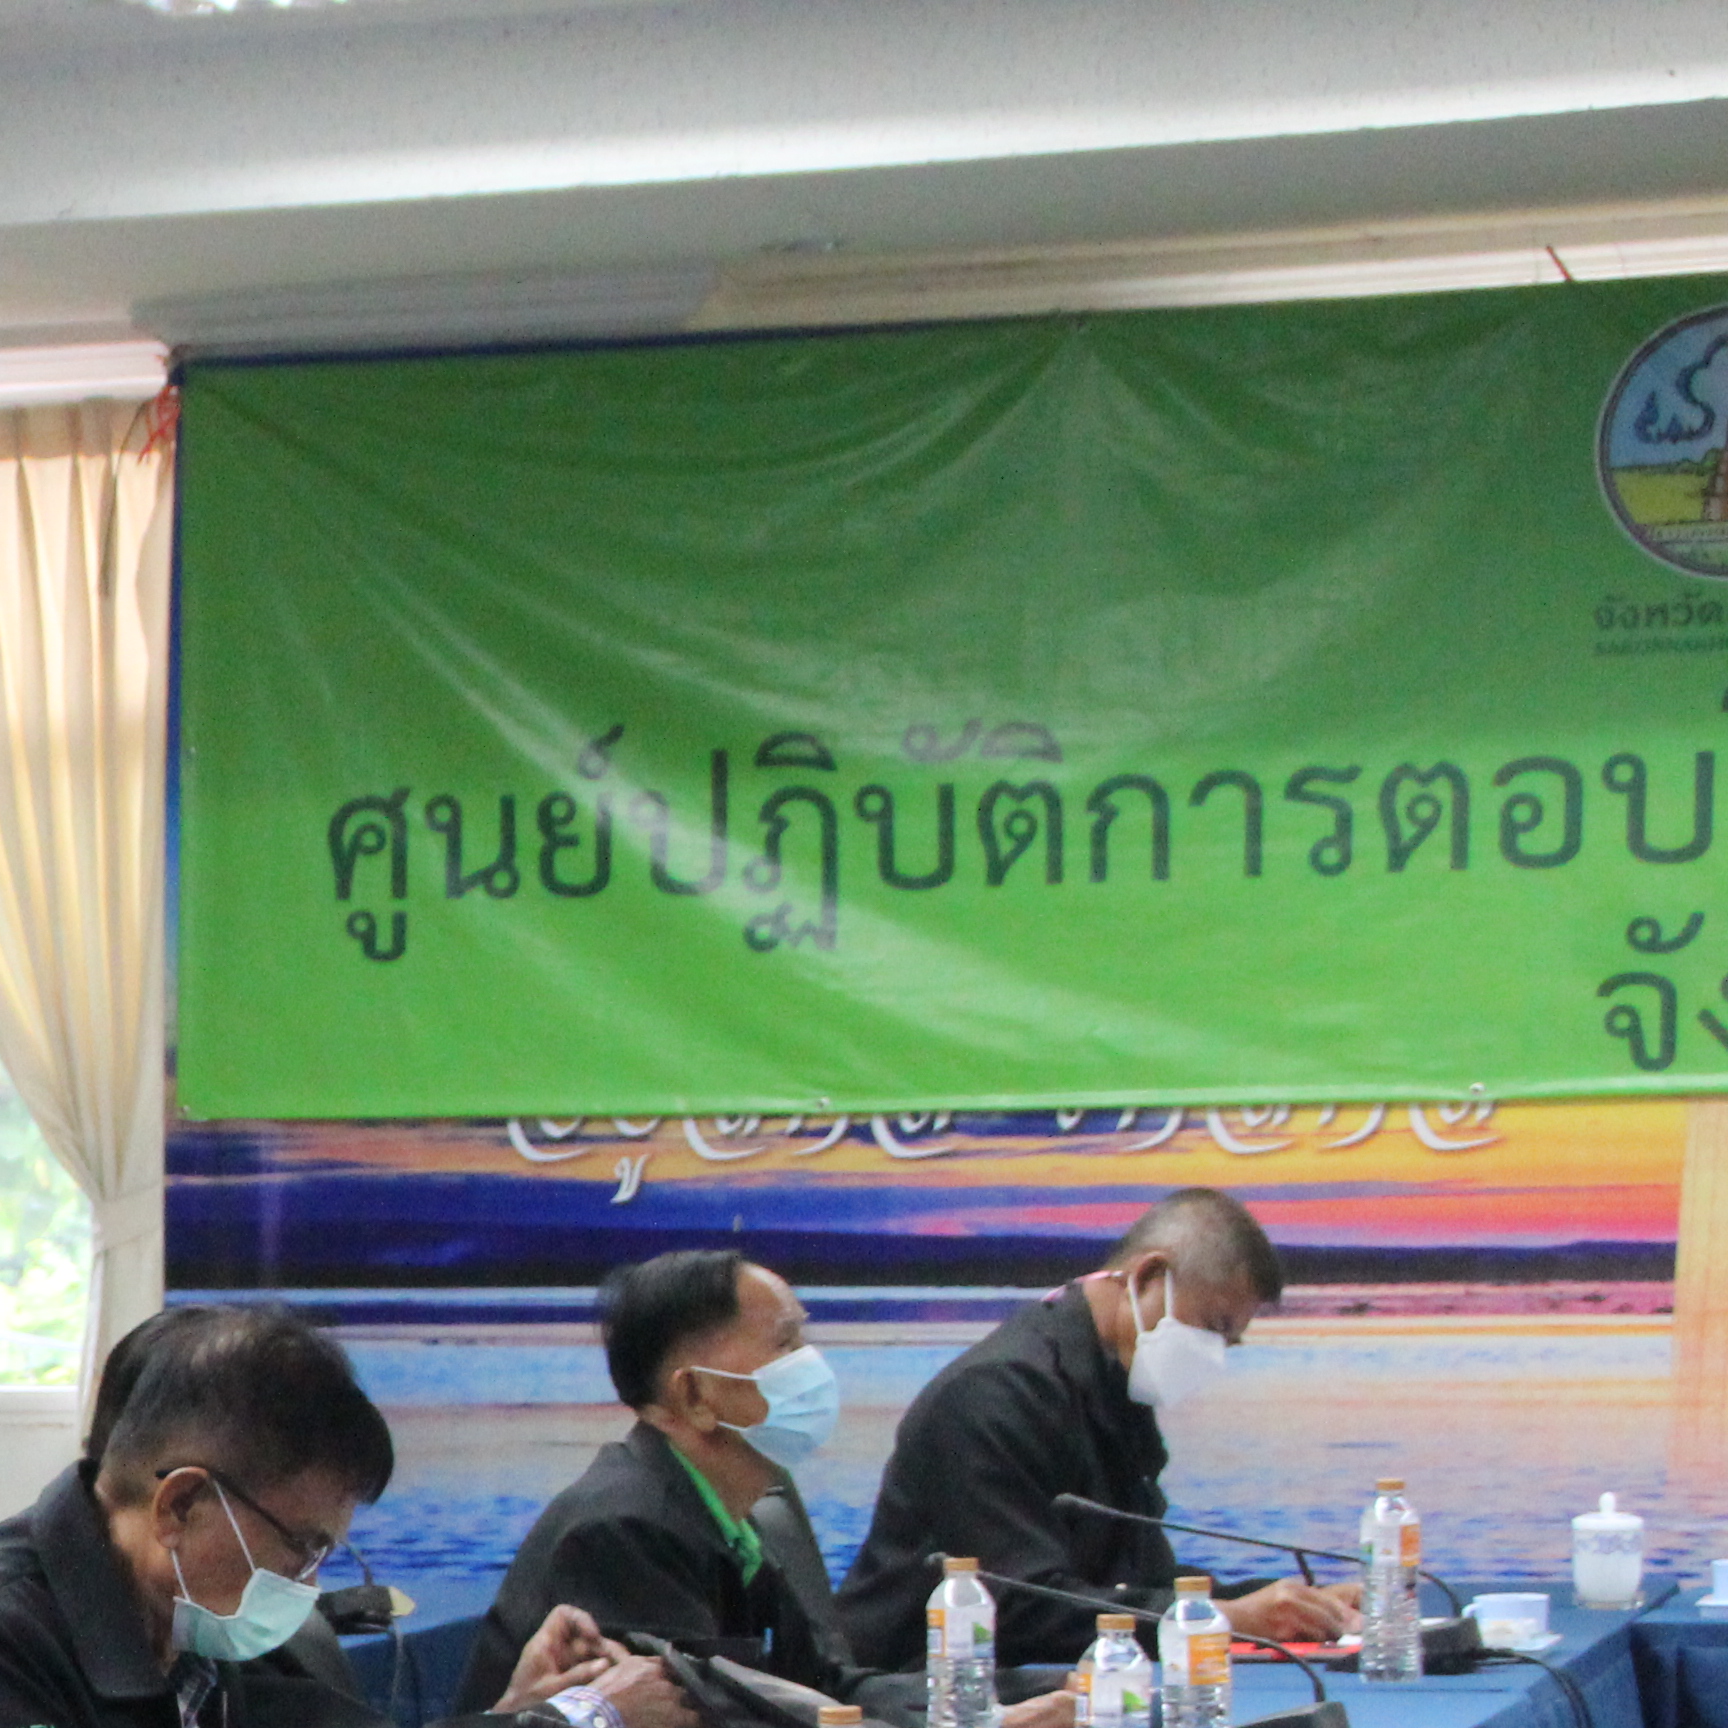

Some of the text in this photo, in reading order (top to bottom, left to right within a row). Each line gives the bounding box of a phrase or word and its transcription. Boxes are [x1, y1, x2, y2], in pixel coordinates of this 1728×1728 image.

[327, 705, 1728, 963] ศูนย์ปฏิบัติการตอบ
